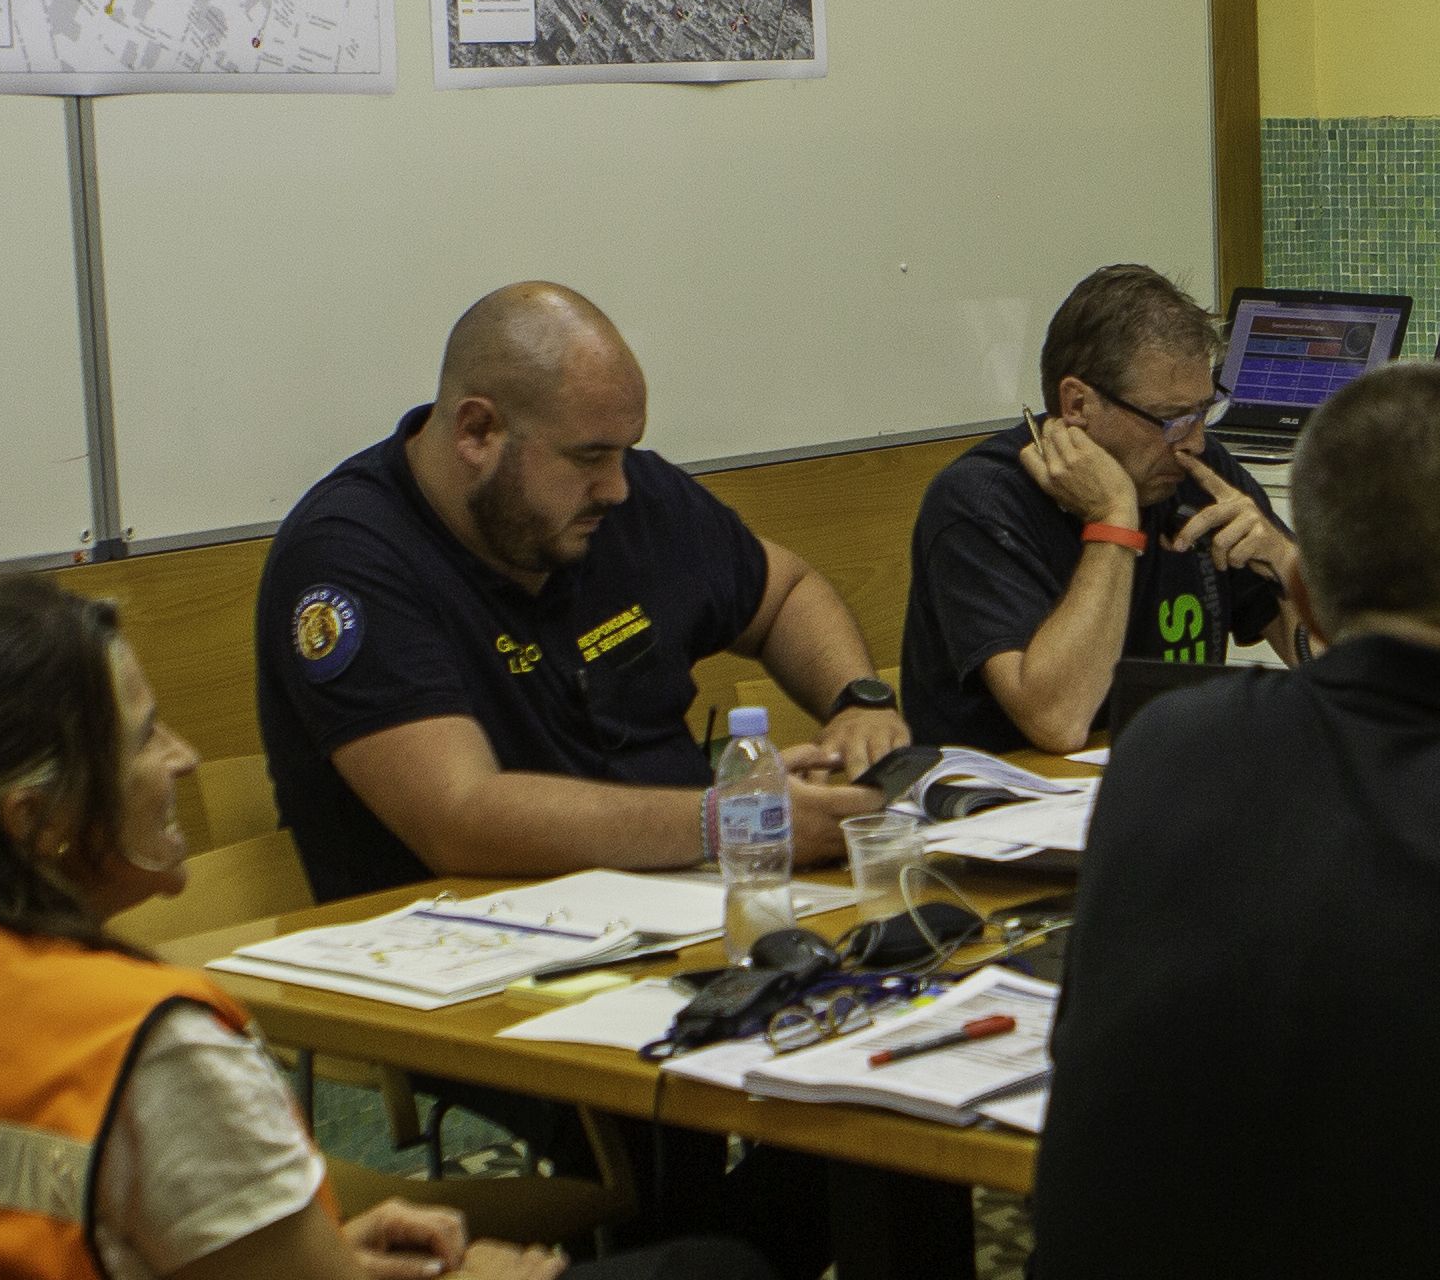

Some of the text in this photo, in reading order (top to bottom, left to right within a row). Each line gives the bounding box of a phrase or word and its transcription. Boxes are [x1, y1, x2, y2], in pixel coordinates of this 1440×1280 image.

[1279, 416, 1300, 425] ASUS
[577, 602, 644, 650] RESPONSABLE
[582, 617, 653, 663] DE SEGURIDAD
